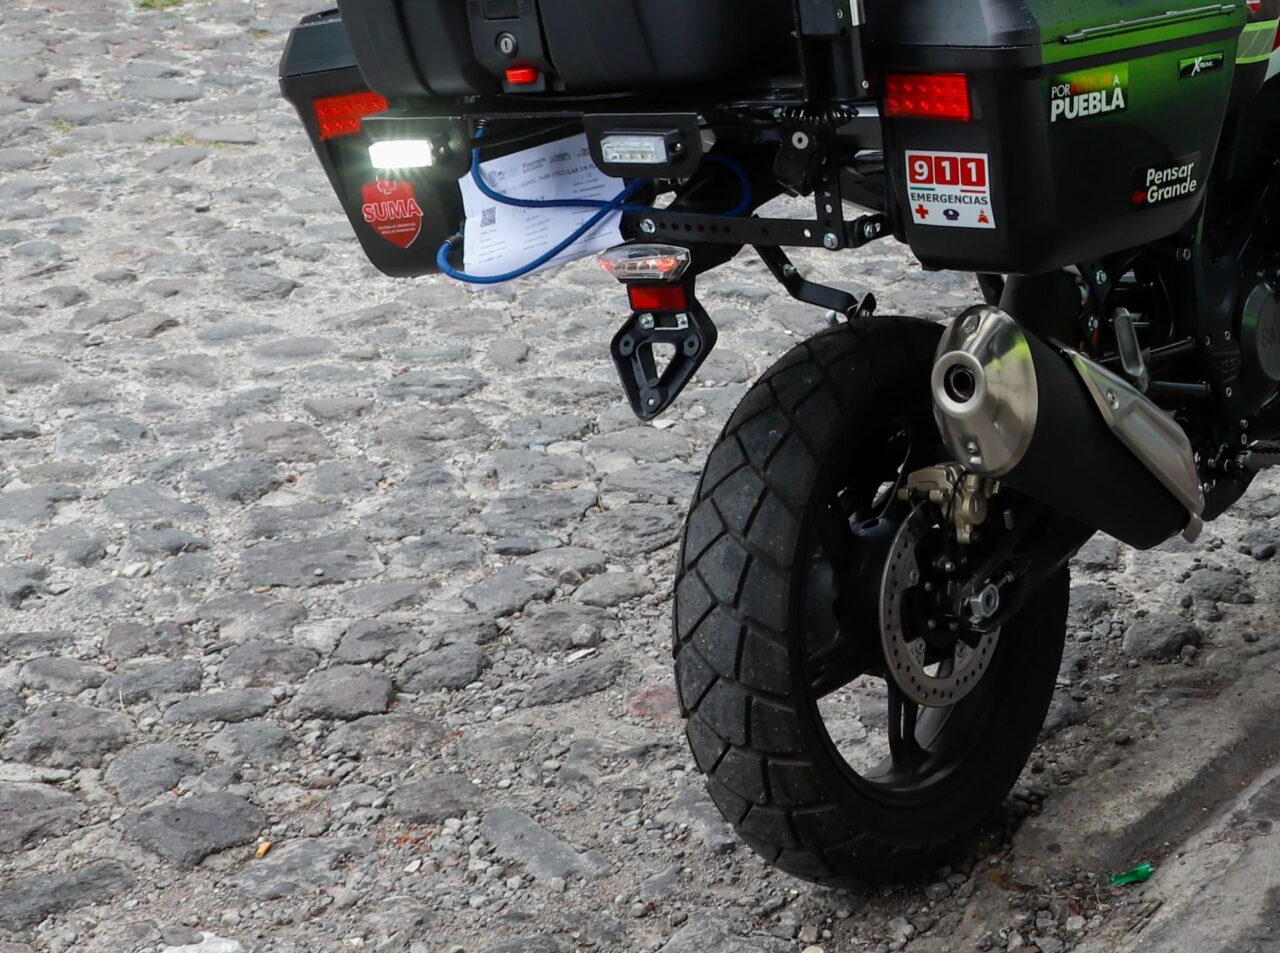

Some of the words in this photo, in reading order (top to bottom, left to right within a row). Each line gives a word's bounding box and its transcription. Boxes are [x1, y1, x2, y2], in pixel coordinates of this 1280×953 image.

[1051, 84, 1071, 99] POR
[1112, 74, 1120, 86] A
[1050, 87, 1125, 123] PUEBLA
[913, 160, 978, 183] 911
[1146, 162, 1195, 186] Pensar
[911, 192, 989, 206] EMERGENCIAS
[1147, 177, 1198, 203] Grande
[361, 197, 425, 223] SUMA
